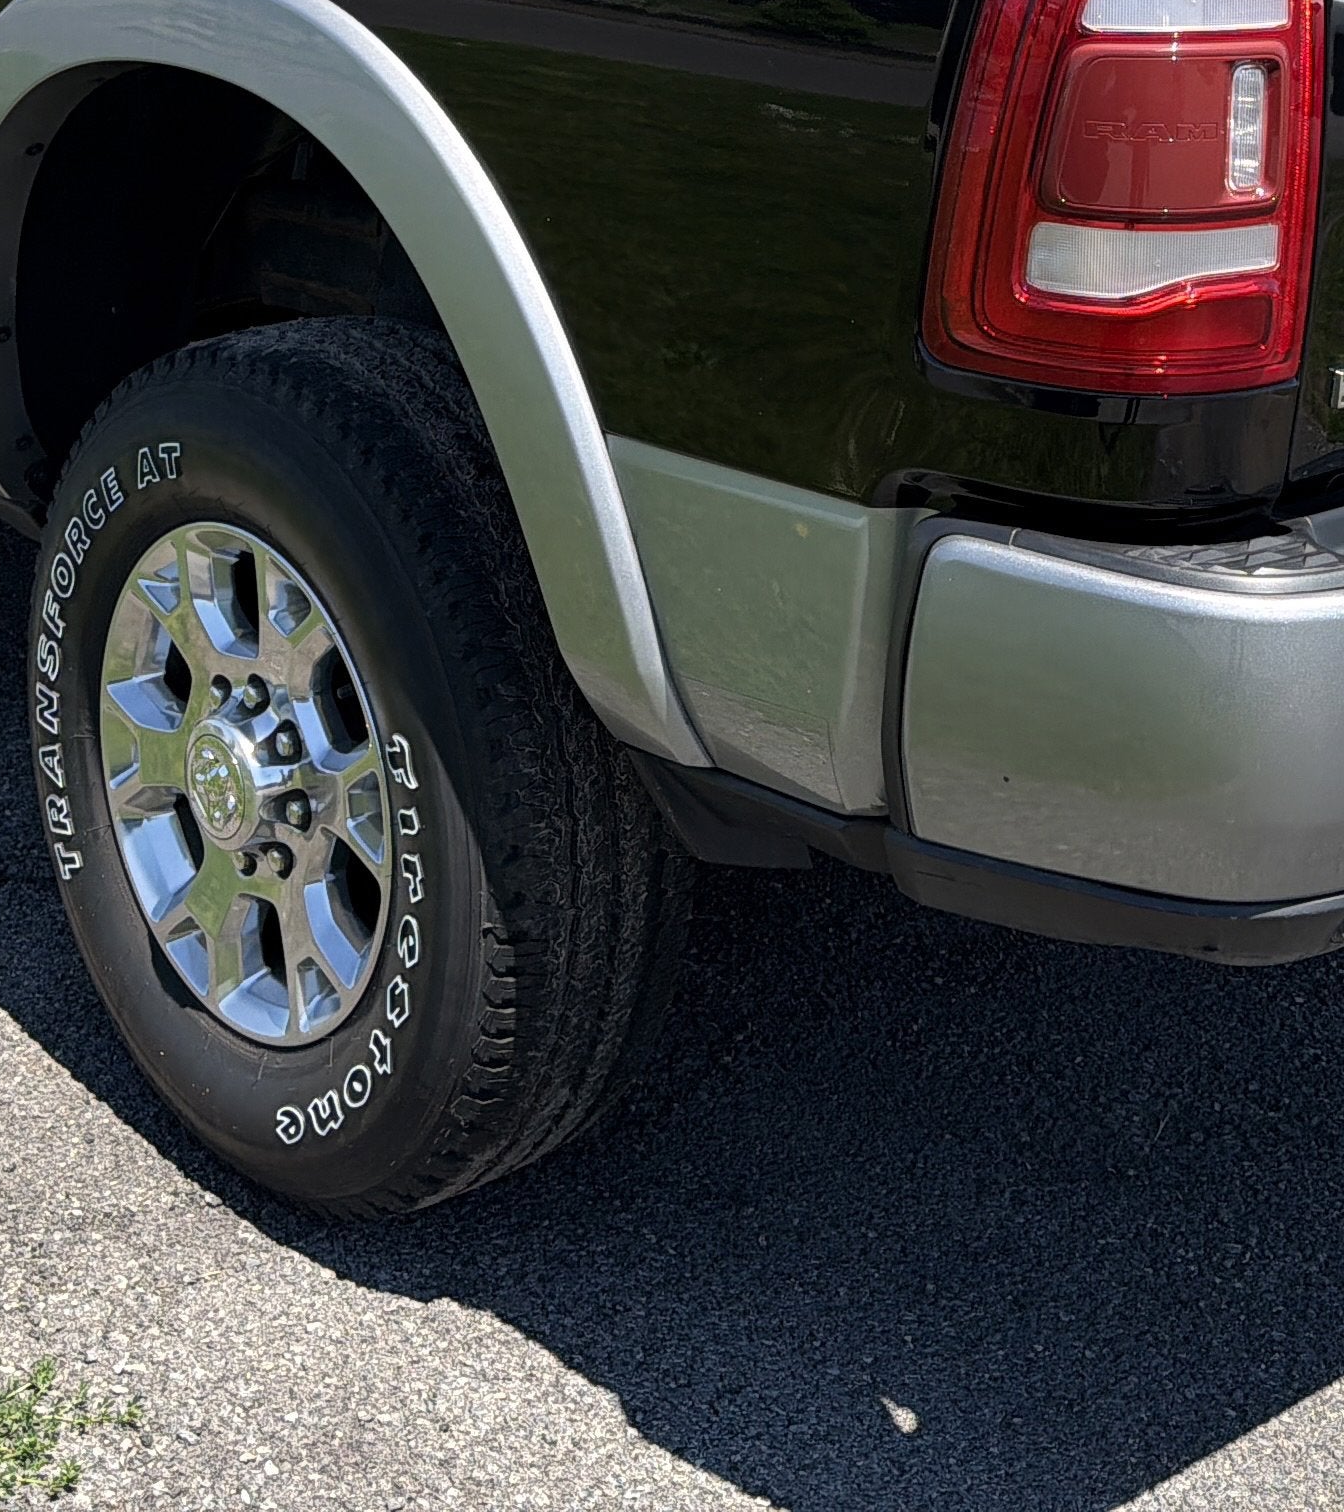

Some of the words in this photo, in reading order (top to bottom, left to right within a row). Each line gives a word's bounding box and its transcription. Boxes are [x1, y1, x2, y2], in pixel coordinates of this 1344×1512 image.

[1083, 120, 1219, 142] RAM
[35, 466, 125, 881] TRANSFORCE
[136, 442, 181, 490] AT
[276, 733, 425, 1145] Firestone
